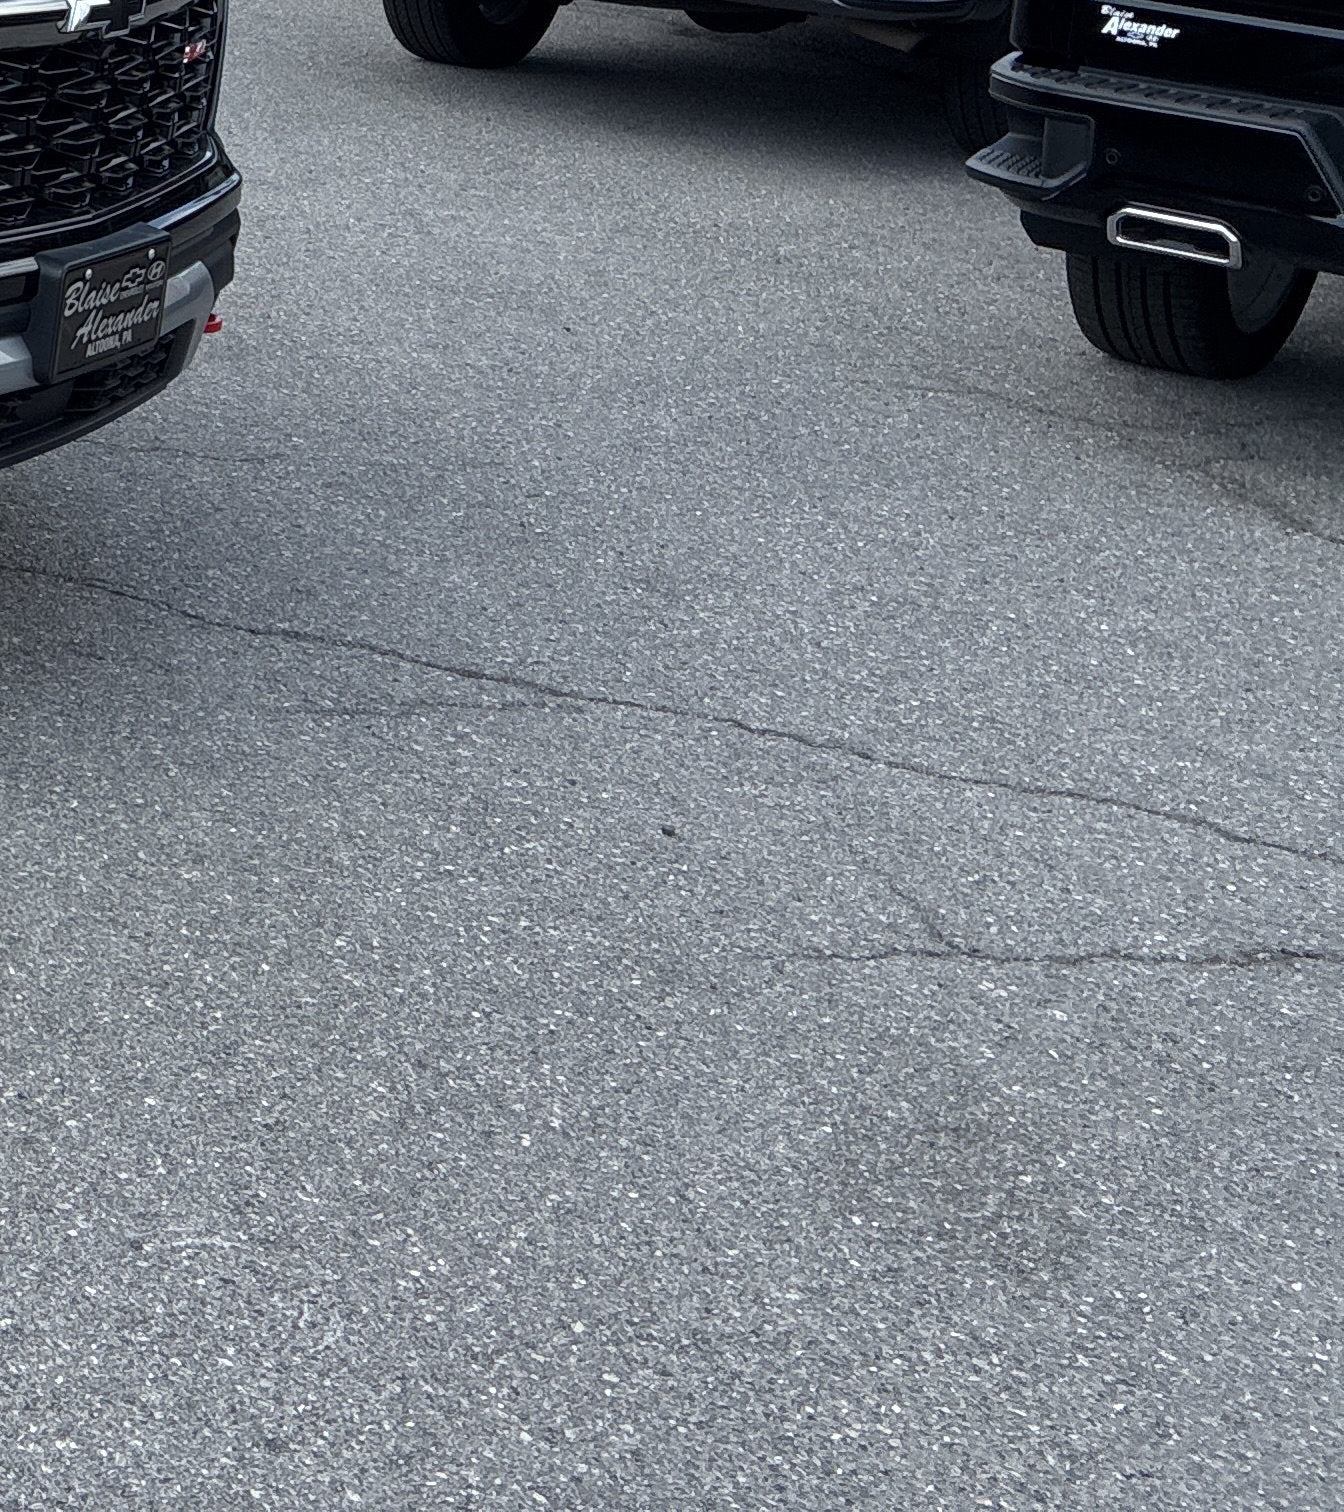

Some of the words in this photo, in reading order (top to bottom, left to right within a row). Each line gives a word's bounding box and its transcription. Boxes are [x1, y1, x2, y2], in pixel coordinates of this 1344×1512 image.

[1100, 4, 1135, 19] Blaise
[1101, 16, 1180, 39] Alexander
[64, 281, 120, 317] Blaise
[71, 294, 160, 350] Alexander
[122, 329, 132, 345] PA
